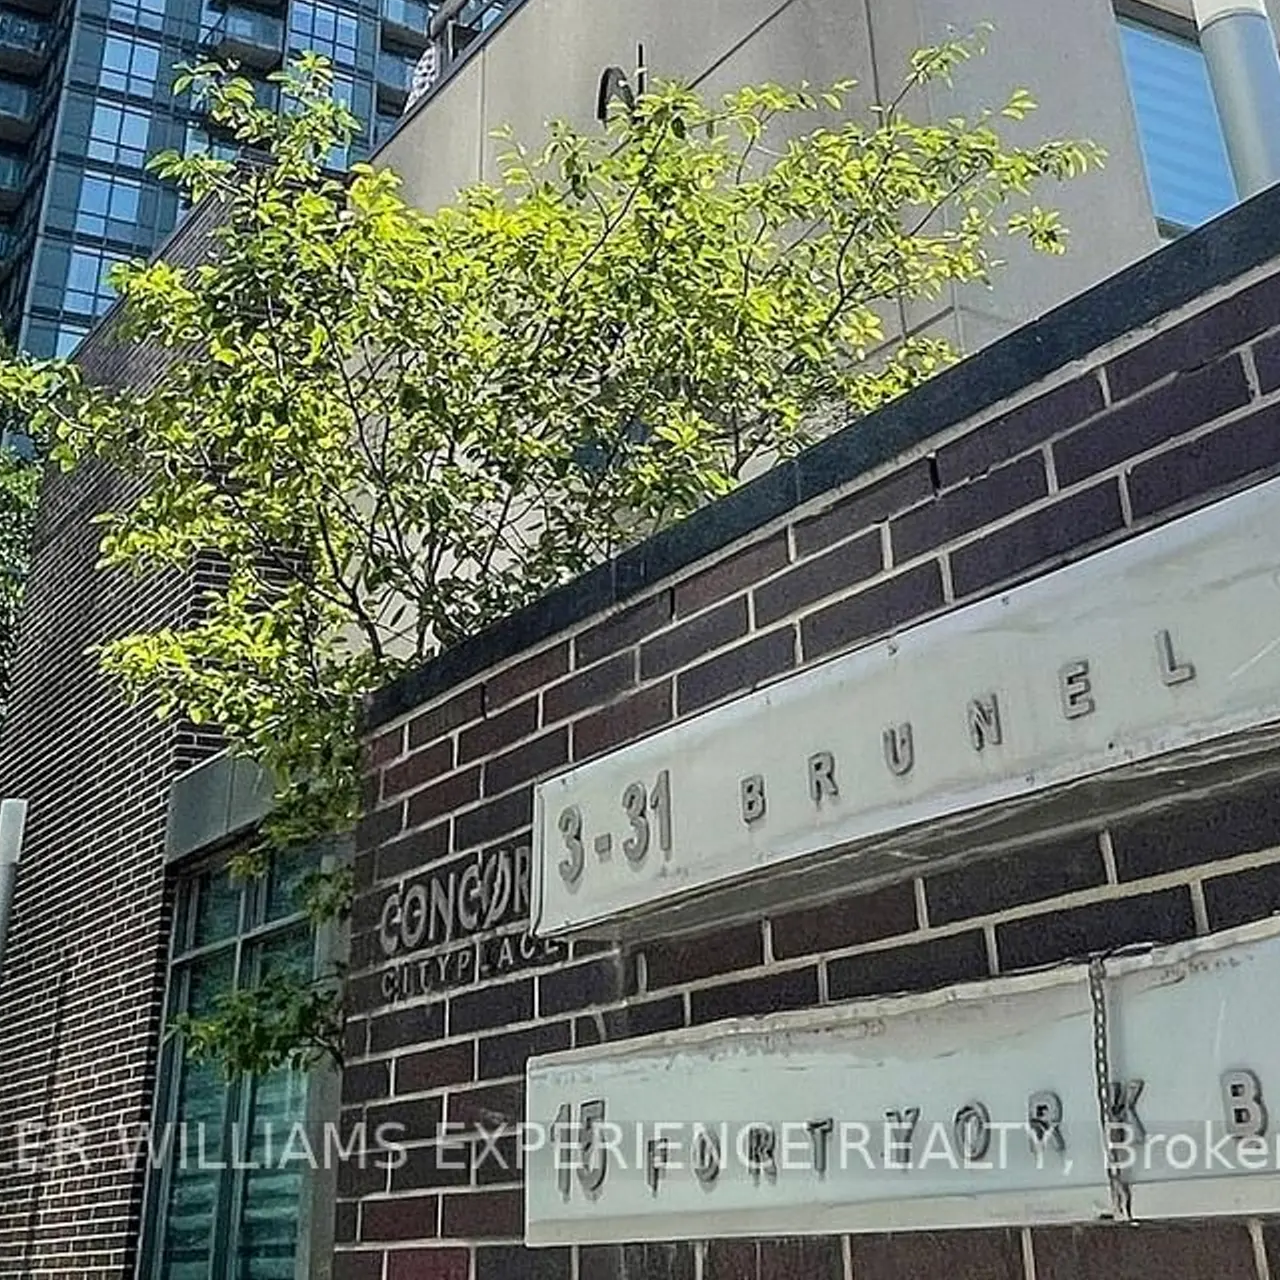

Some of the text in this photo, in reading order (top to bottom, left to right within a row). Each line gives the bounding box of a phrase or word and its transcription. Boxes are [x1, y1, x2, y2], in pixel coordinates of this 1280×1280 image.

[557, 770, 673, 885] 3-31
[740, 628, 1196, 824] BRUNEL
[380, 846, 531, 955] CONCOR
[550, 1099, 606, 1197] 15
[646, 1117, 834, 1195] FORT
